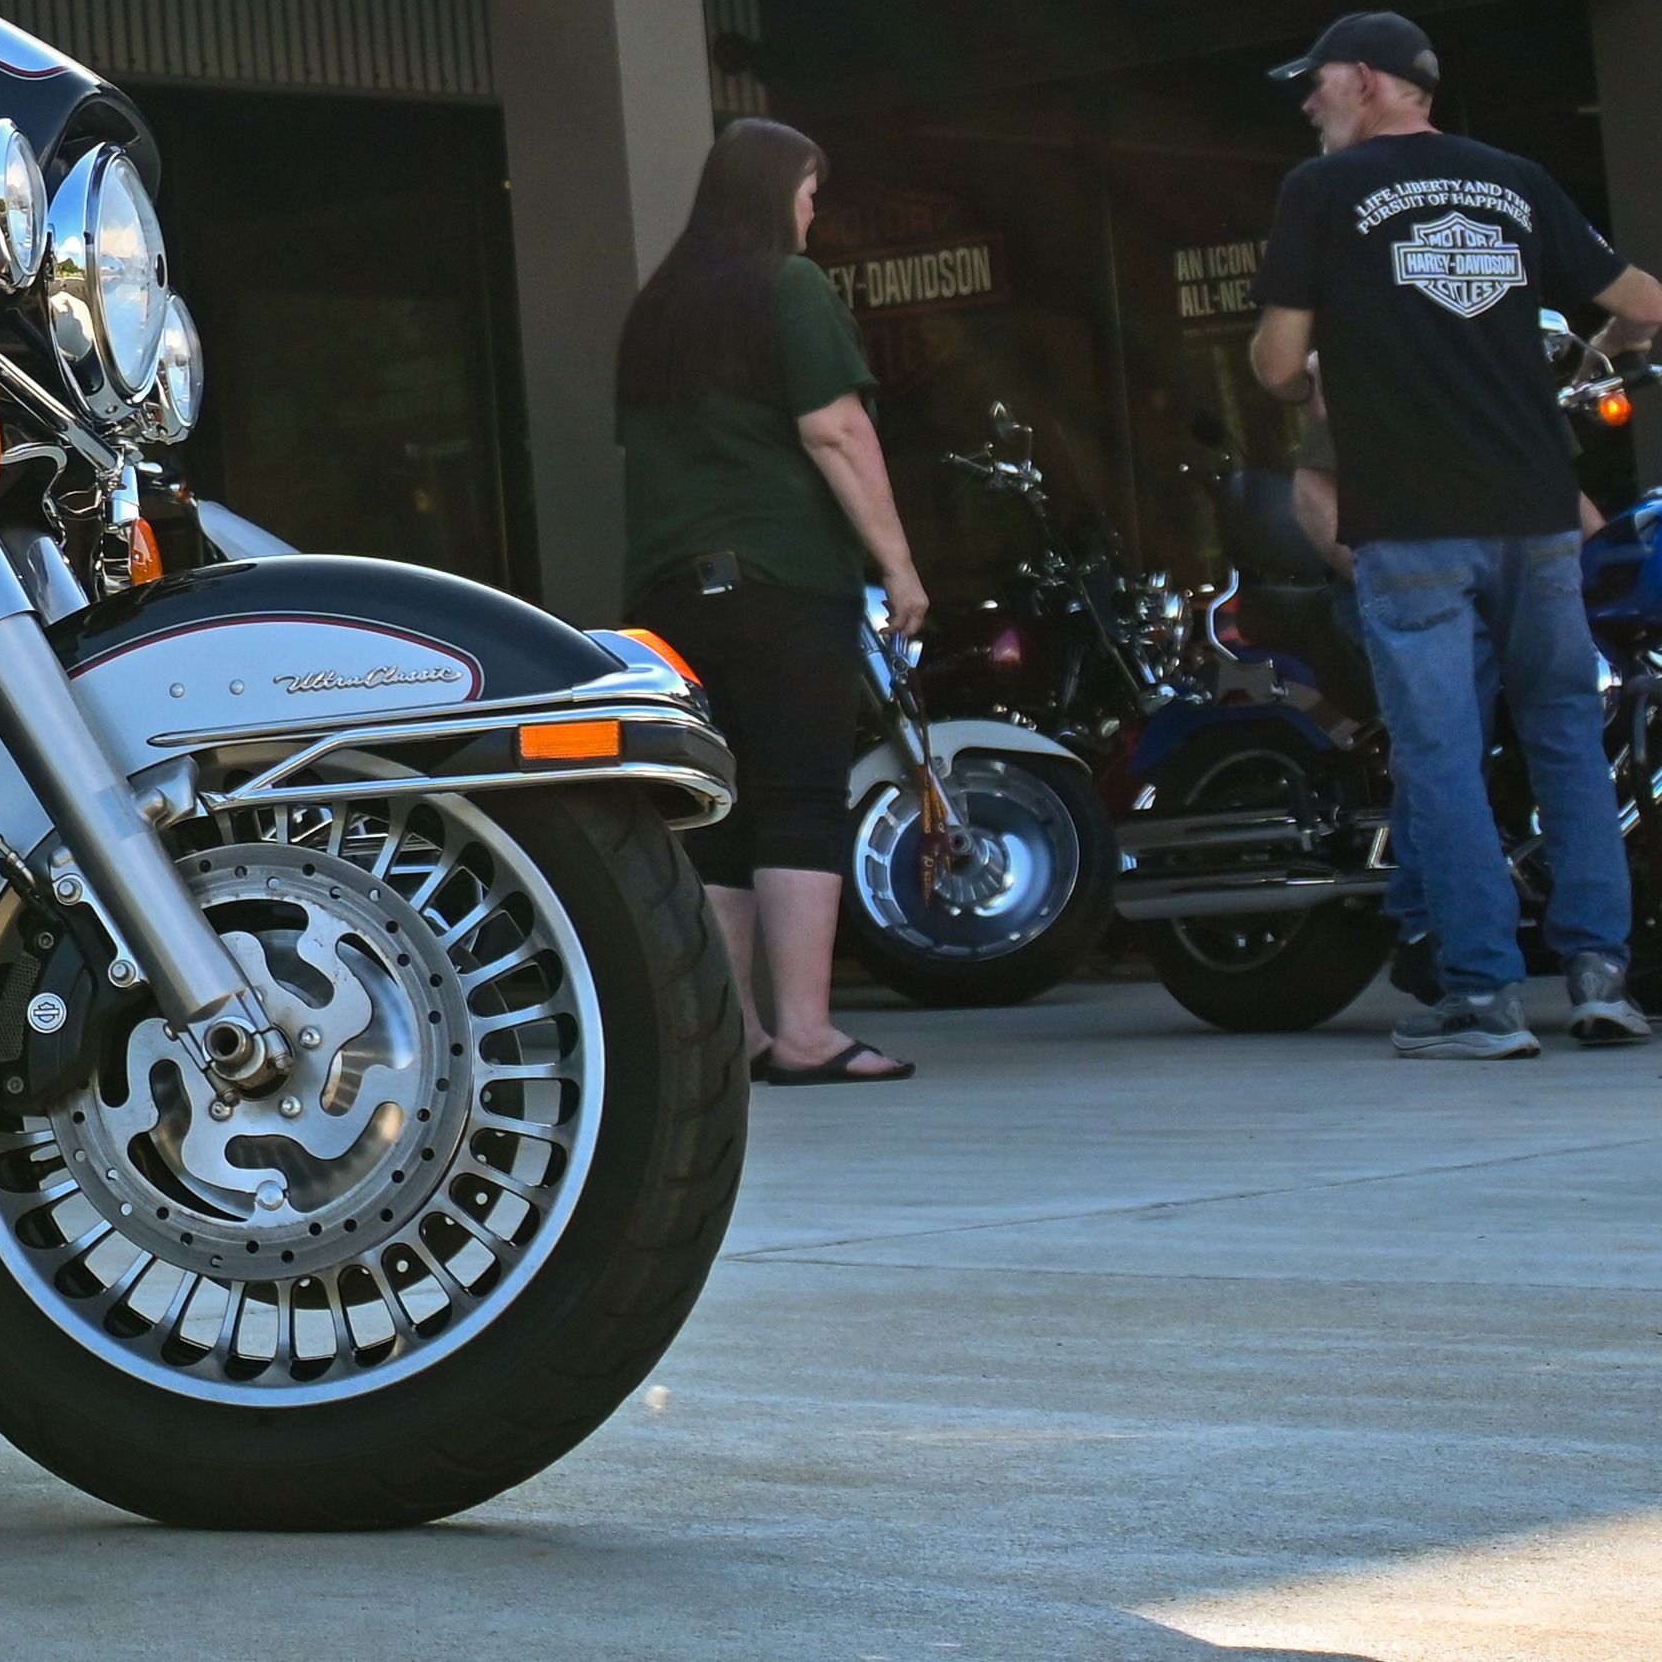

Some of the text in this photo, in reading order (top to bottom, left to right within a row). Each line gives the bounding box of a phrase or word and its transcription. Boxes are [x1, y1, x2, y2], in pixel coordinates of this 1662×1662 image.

[1395, 178, 1462, 196] LIBERTY
[1464, 179, 1503, 196] AND
[1356, 195, 1426, 235] PURSUIT
[1426, 193, 1451, 207] OF
[1428, 224, 1487, 247] MOTOR
[1177, 248, 1204, 282] AN
[1208, 242, 1257, 277] ICON
[1406, 252, 1515, 276] HARLEY-DAVIDSON
[828, 245, 992, 310] EY-DAVIDSON
[1436, 281, 1493, 308] CYCLES
